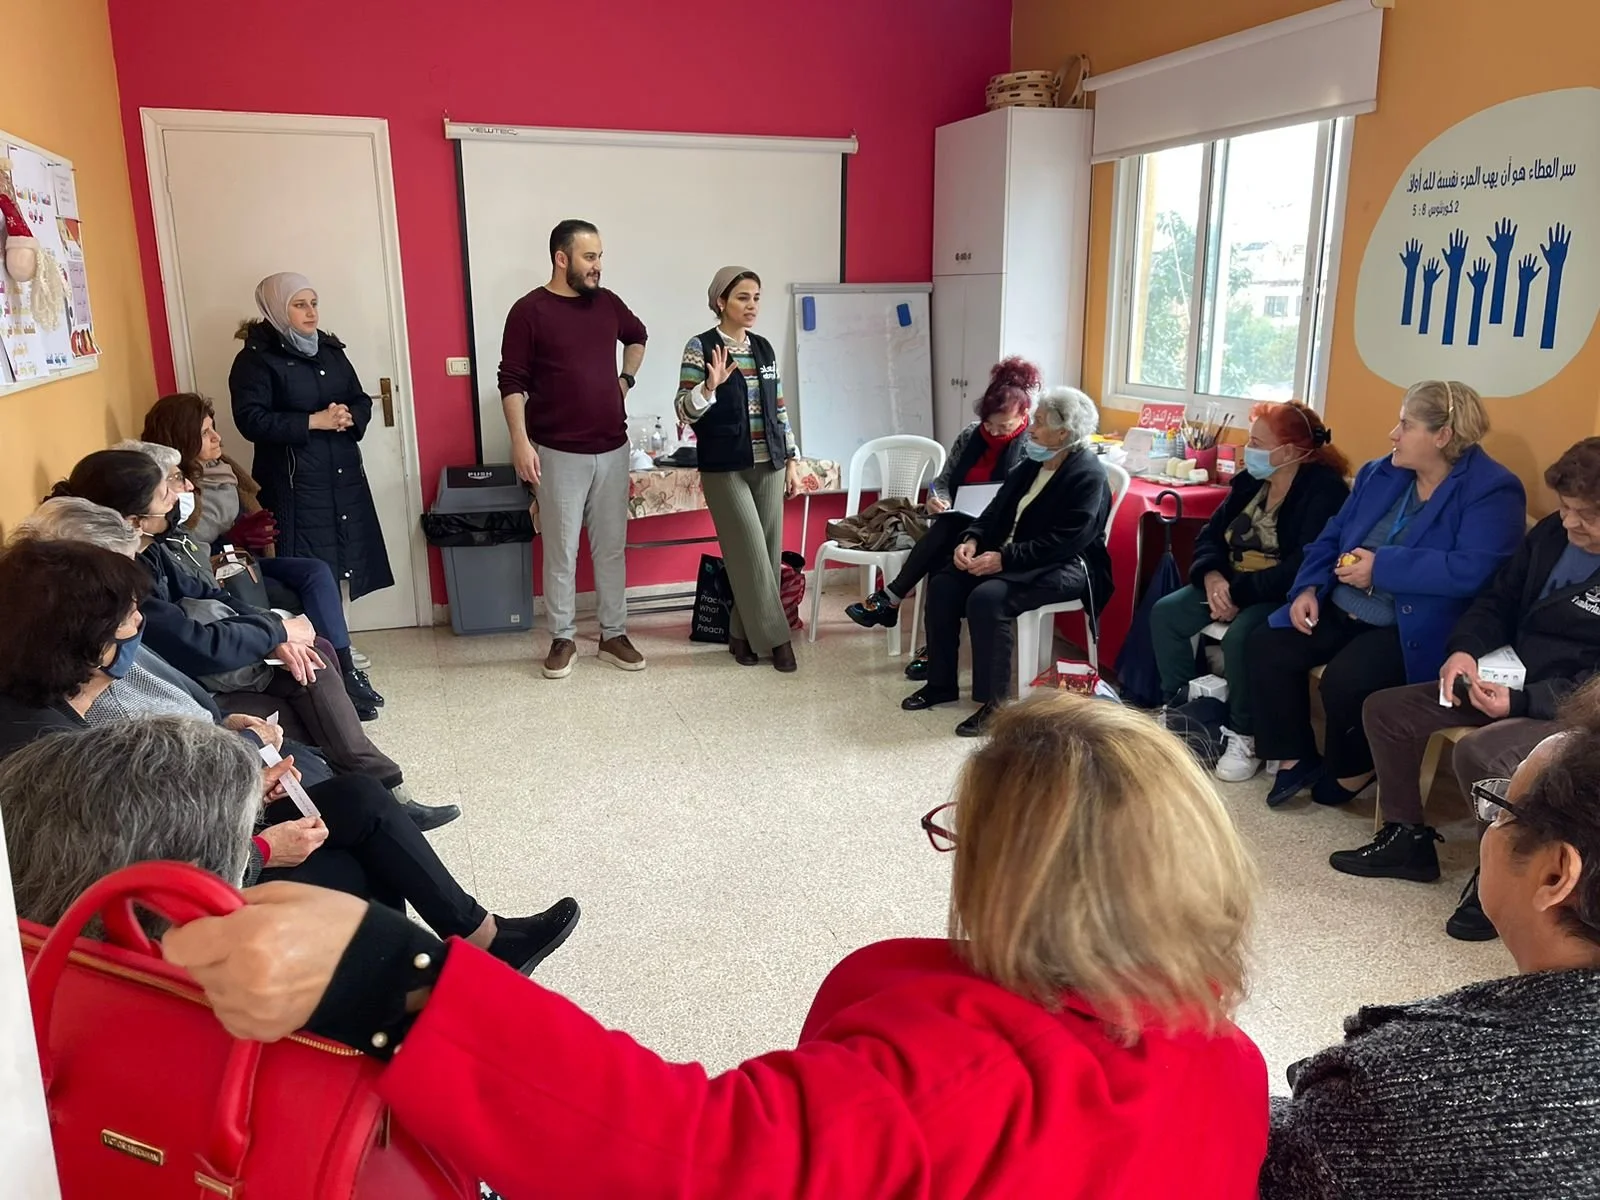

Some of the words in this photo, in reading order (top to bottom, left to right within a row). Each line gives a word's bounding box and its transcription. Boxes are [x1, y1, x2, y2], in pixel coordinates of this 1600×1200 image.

[1460, 165, 1482, 190] المرء
[1512, 166, 1526, 186] هو
[1529, 157, 1559, 180] العطاء
[1559, 163, 1576, 181] سر
[1422, 170, 1436, 191] لله
[1482, 171, 1499, 190] يهب
[1454, 200, 1460, 213] 2
[698, 613, 712, 623] You
[699, 604, 719, 614] What
[696, 623, 725, 635] Preach
